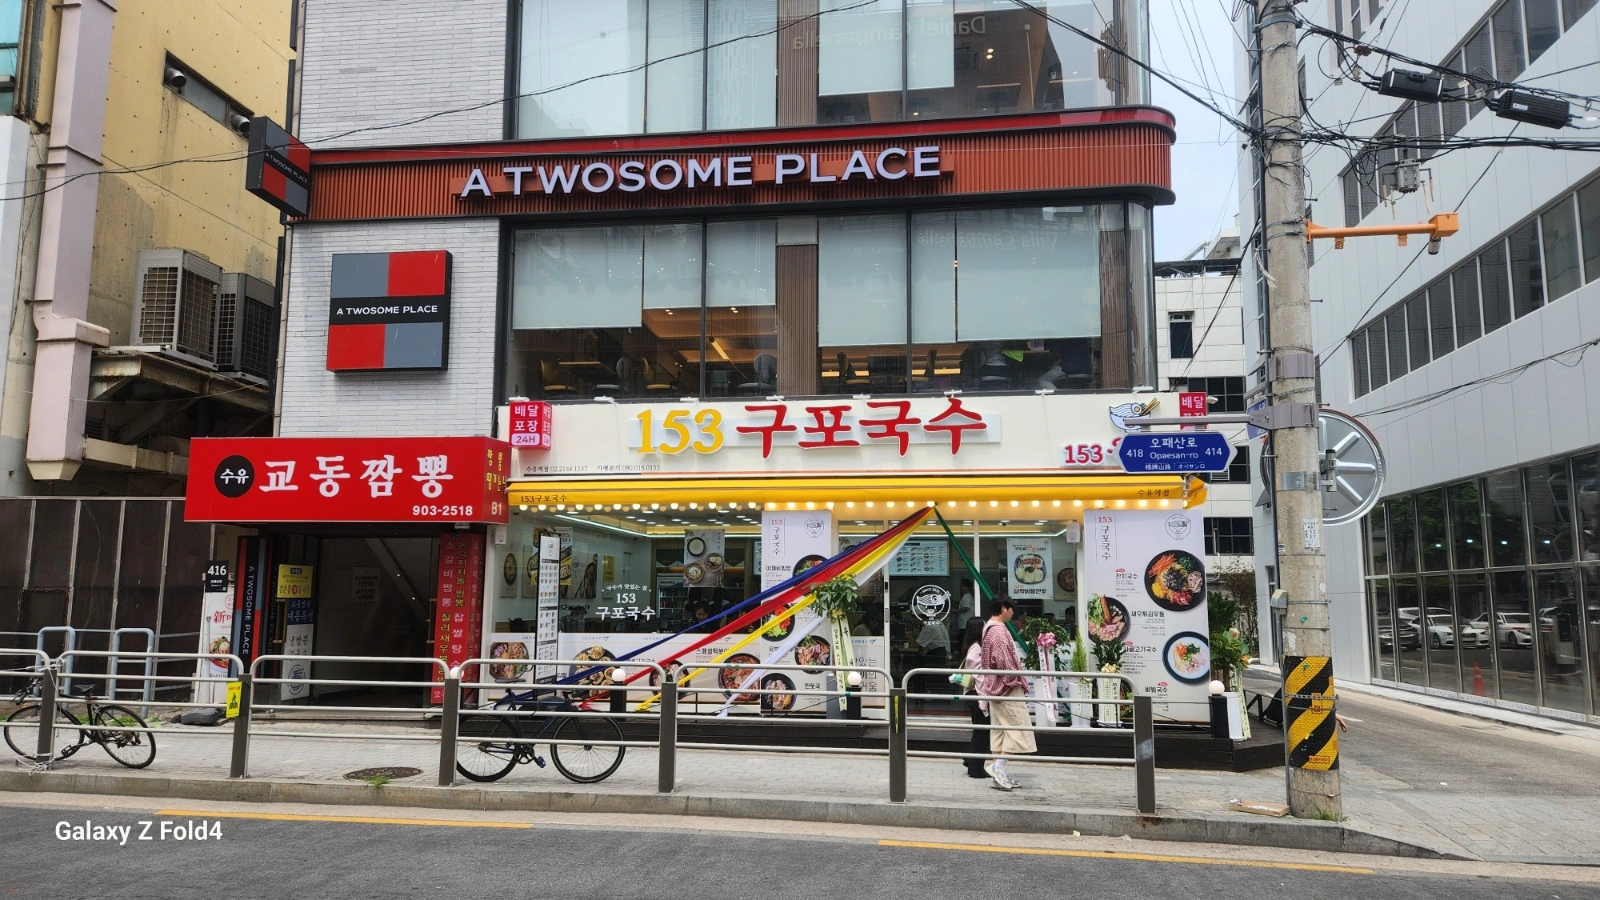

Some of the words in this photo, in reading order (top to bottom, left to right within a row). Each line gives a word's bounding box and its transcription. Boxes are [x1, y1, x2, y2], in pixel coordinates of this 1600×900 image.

[270, 155, 293, 173] TWOSOME
[461, 168, 492, 197] A
[503, 156, 753, 196] TWOSOME
[775, 146, 940, 185] PLACE
[336, 308, 344, 316] A
[346, 306, 400, 315] TWOSOME
[402, 305, 438, 314] PLACE
[1182, 396, 1204, 409] 배달
[514, 404, 539, 417] 배달
[513, 420, 538, 432] 포장
[635, 408, 724, 454] 153
[735, 397, 987, 458] 구포국수
[516, 435, 536, 443] 24H
[1150, 437, 1198, 449] 오패산로
[1064, 444, 1103, 464] 153
[1126, 449, 1144, 458] 418
[1150, 452, 1198, 461] Opaesan-ro
[1205, 448, 1222, 456] 414
[220, 468, 249, 485] 수유
[259, 454, 454, 498] 교동짬뽕
[412, 505, 473, 516] 903-2518
[491, 501, 502, 516] B1
[1101, 525, 1111, 561] 구포국수
[207, 565, 227, 576] 416
[244, 573, 256, 621] TWOSOME
[616, 592, 636, 604] 153
[595, 605, 656, 622] 구포국수
[242, 626, 250, 655] PLACE
